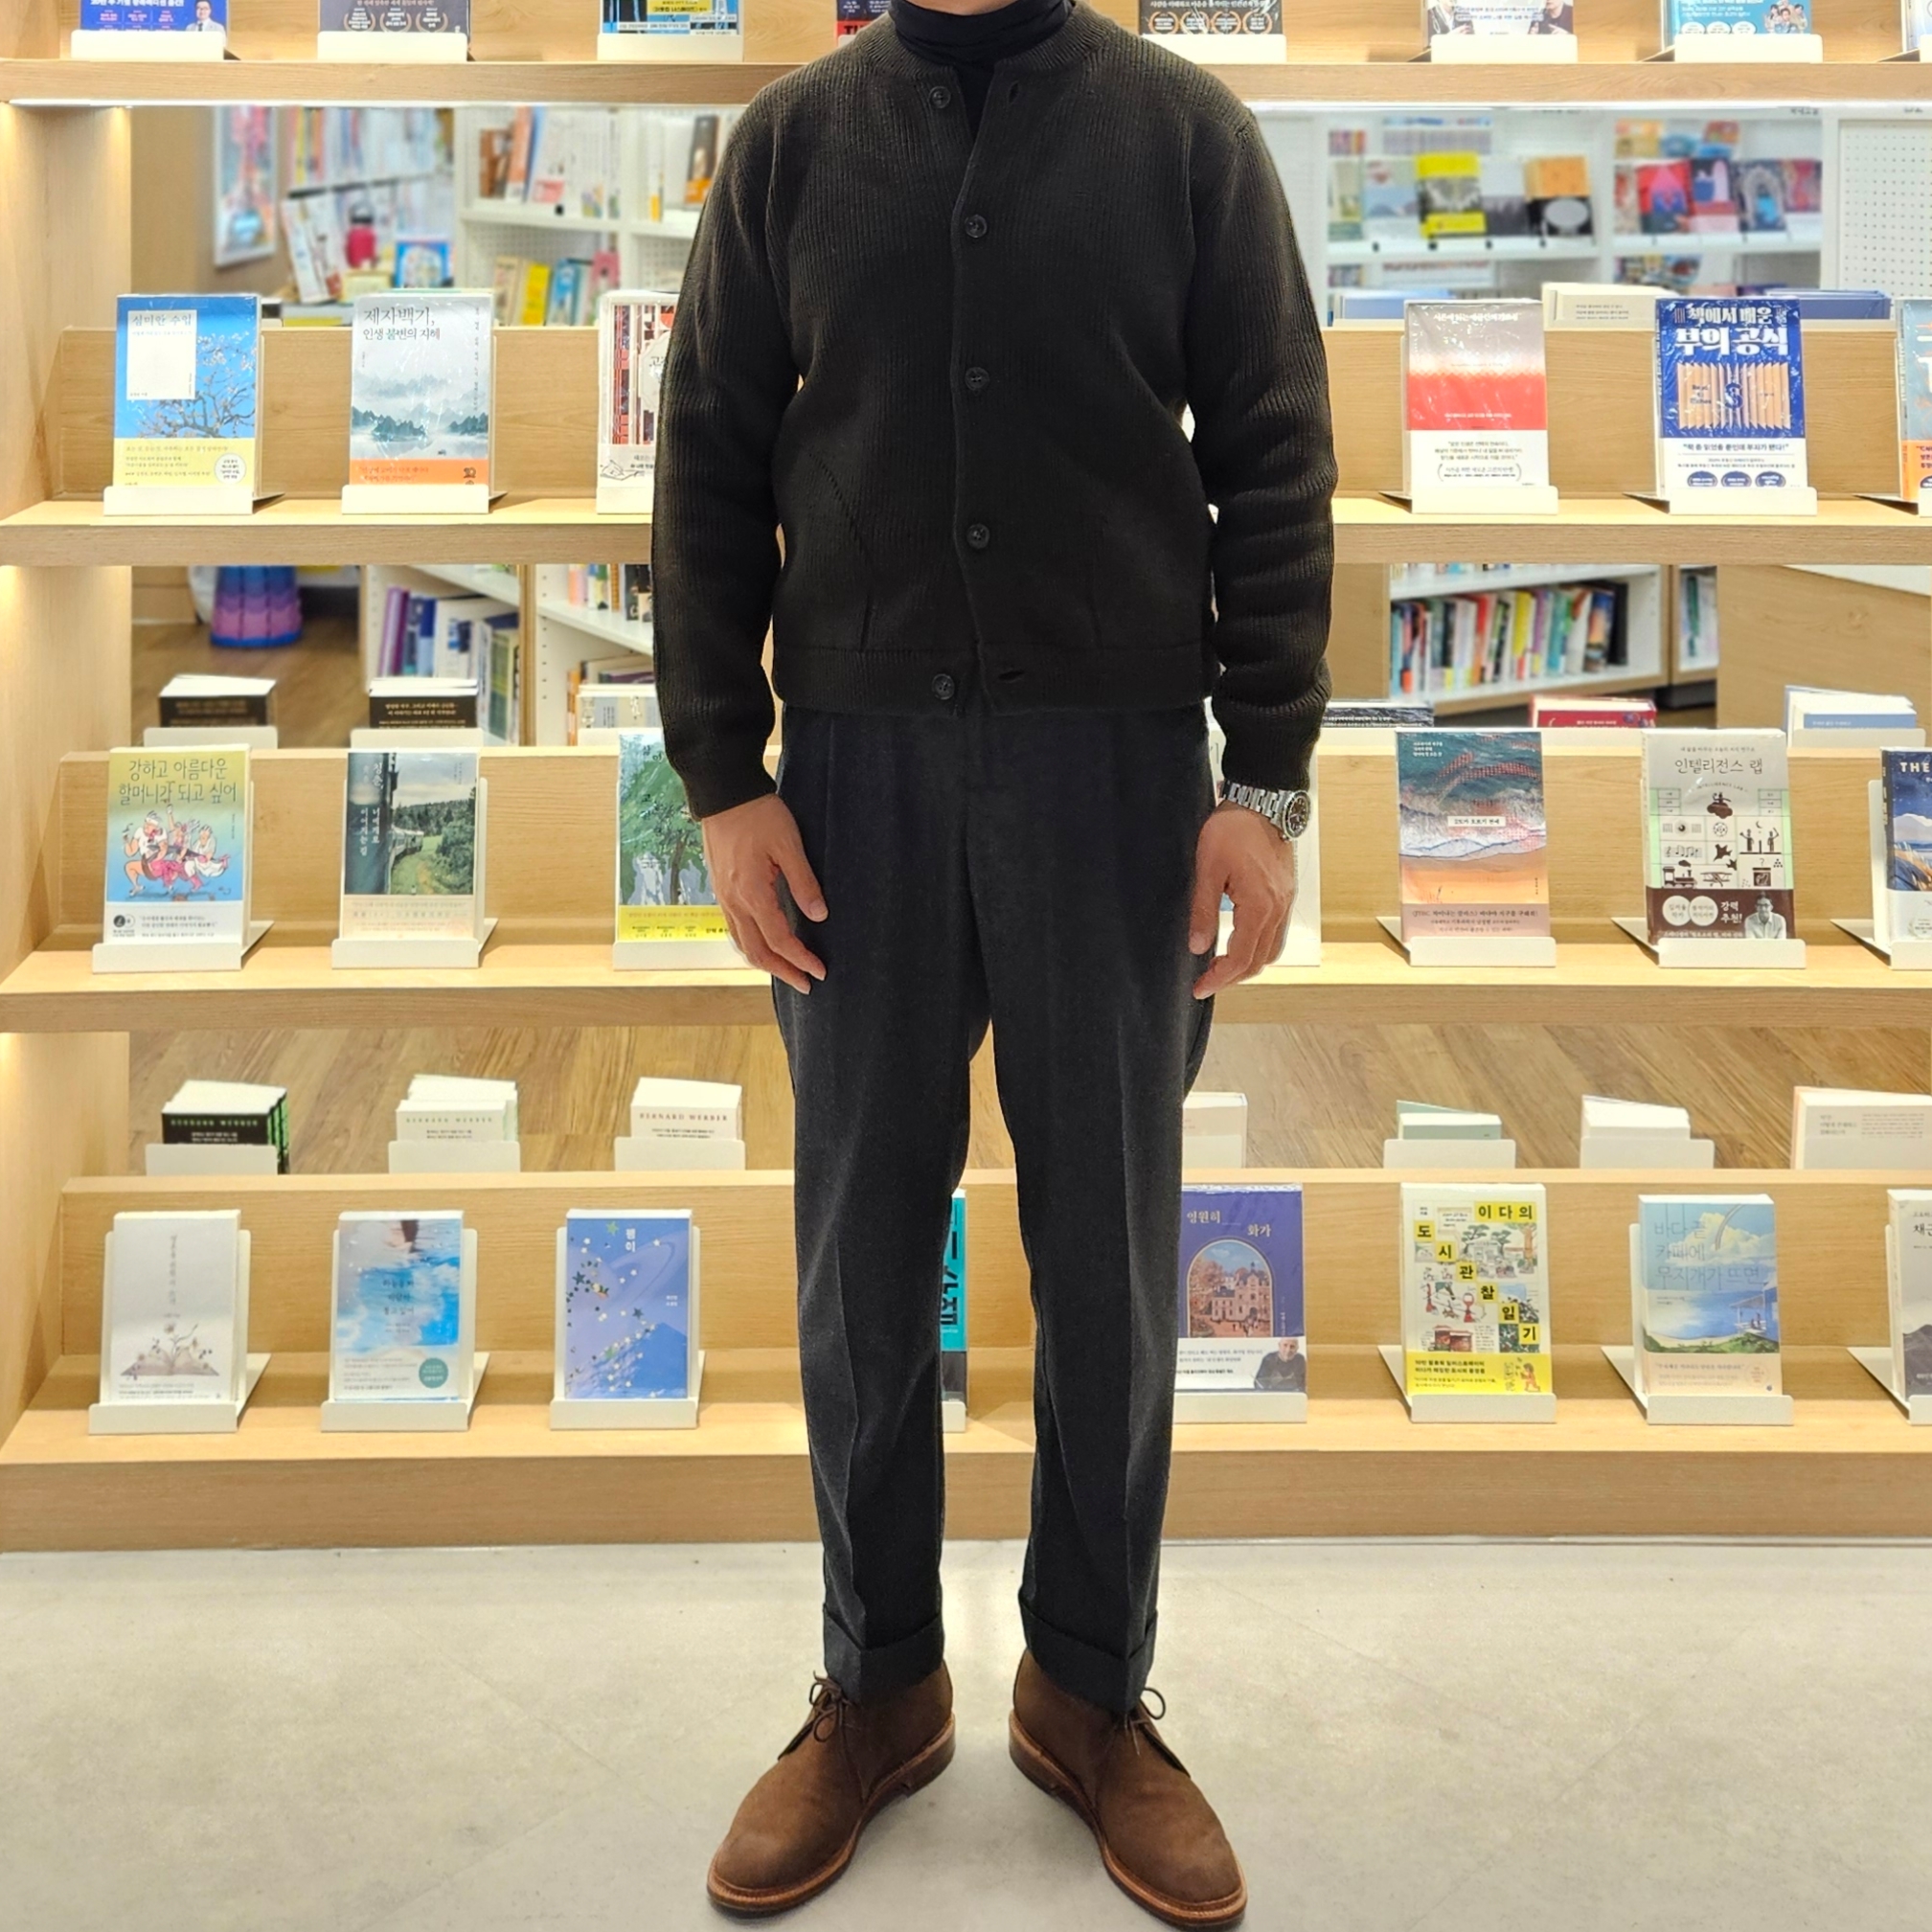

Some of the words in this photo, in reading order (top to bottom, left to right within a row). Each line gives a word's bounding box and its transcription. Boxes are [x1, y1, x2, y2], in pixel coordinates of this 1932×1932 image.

[132, 314, 166, 327] 심미안
[1688, 307, 1738, 324] 책에서
[1740, 307, 1772, 324] 배운
[363, 328, 384, 341] 인생
[1676, 327, 1730, 355] 부의
[1732, 327, 1789, 355] 공식
[130, 760, 168, 781] 강하고
[173, 758, 228, 781] 아름다운
[1674, 759, 1743, 774] 인텔리전스
[1750, 758, 1763, 775] 랩
[1899, 762, 1931, 772] THE
[119, 784, 173, 806] 할머니가
[178, 784, 204, 804] 되고
[210, 783, 237, 804] 싶어
[1478, 1205, 1534, 1219] 이다의
[1247, 1224, 1272, 1238] 화가
[1654, 1213, 1689, 1239] 바다
[1655, 1244, 1706, 1261] 카페에
[1655, 1266, 1723, 1290] 무지개가
[1727, 1266, 1765, 1285] 뜨면
